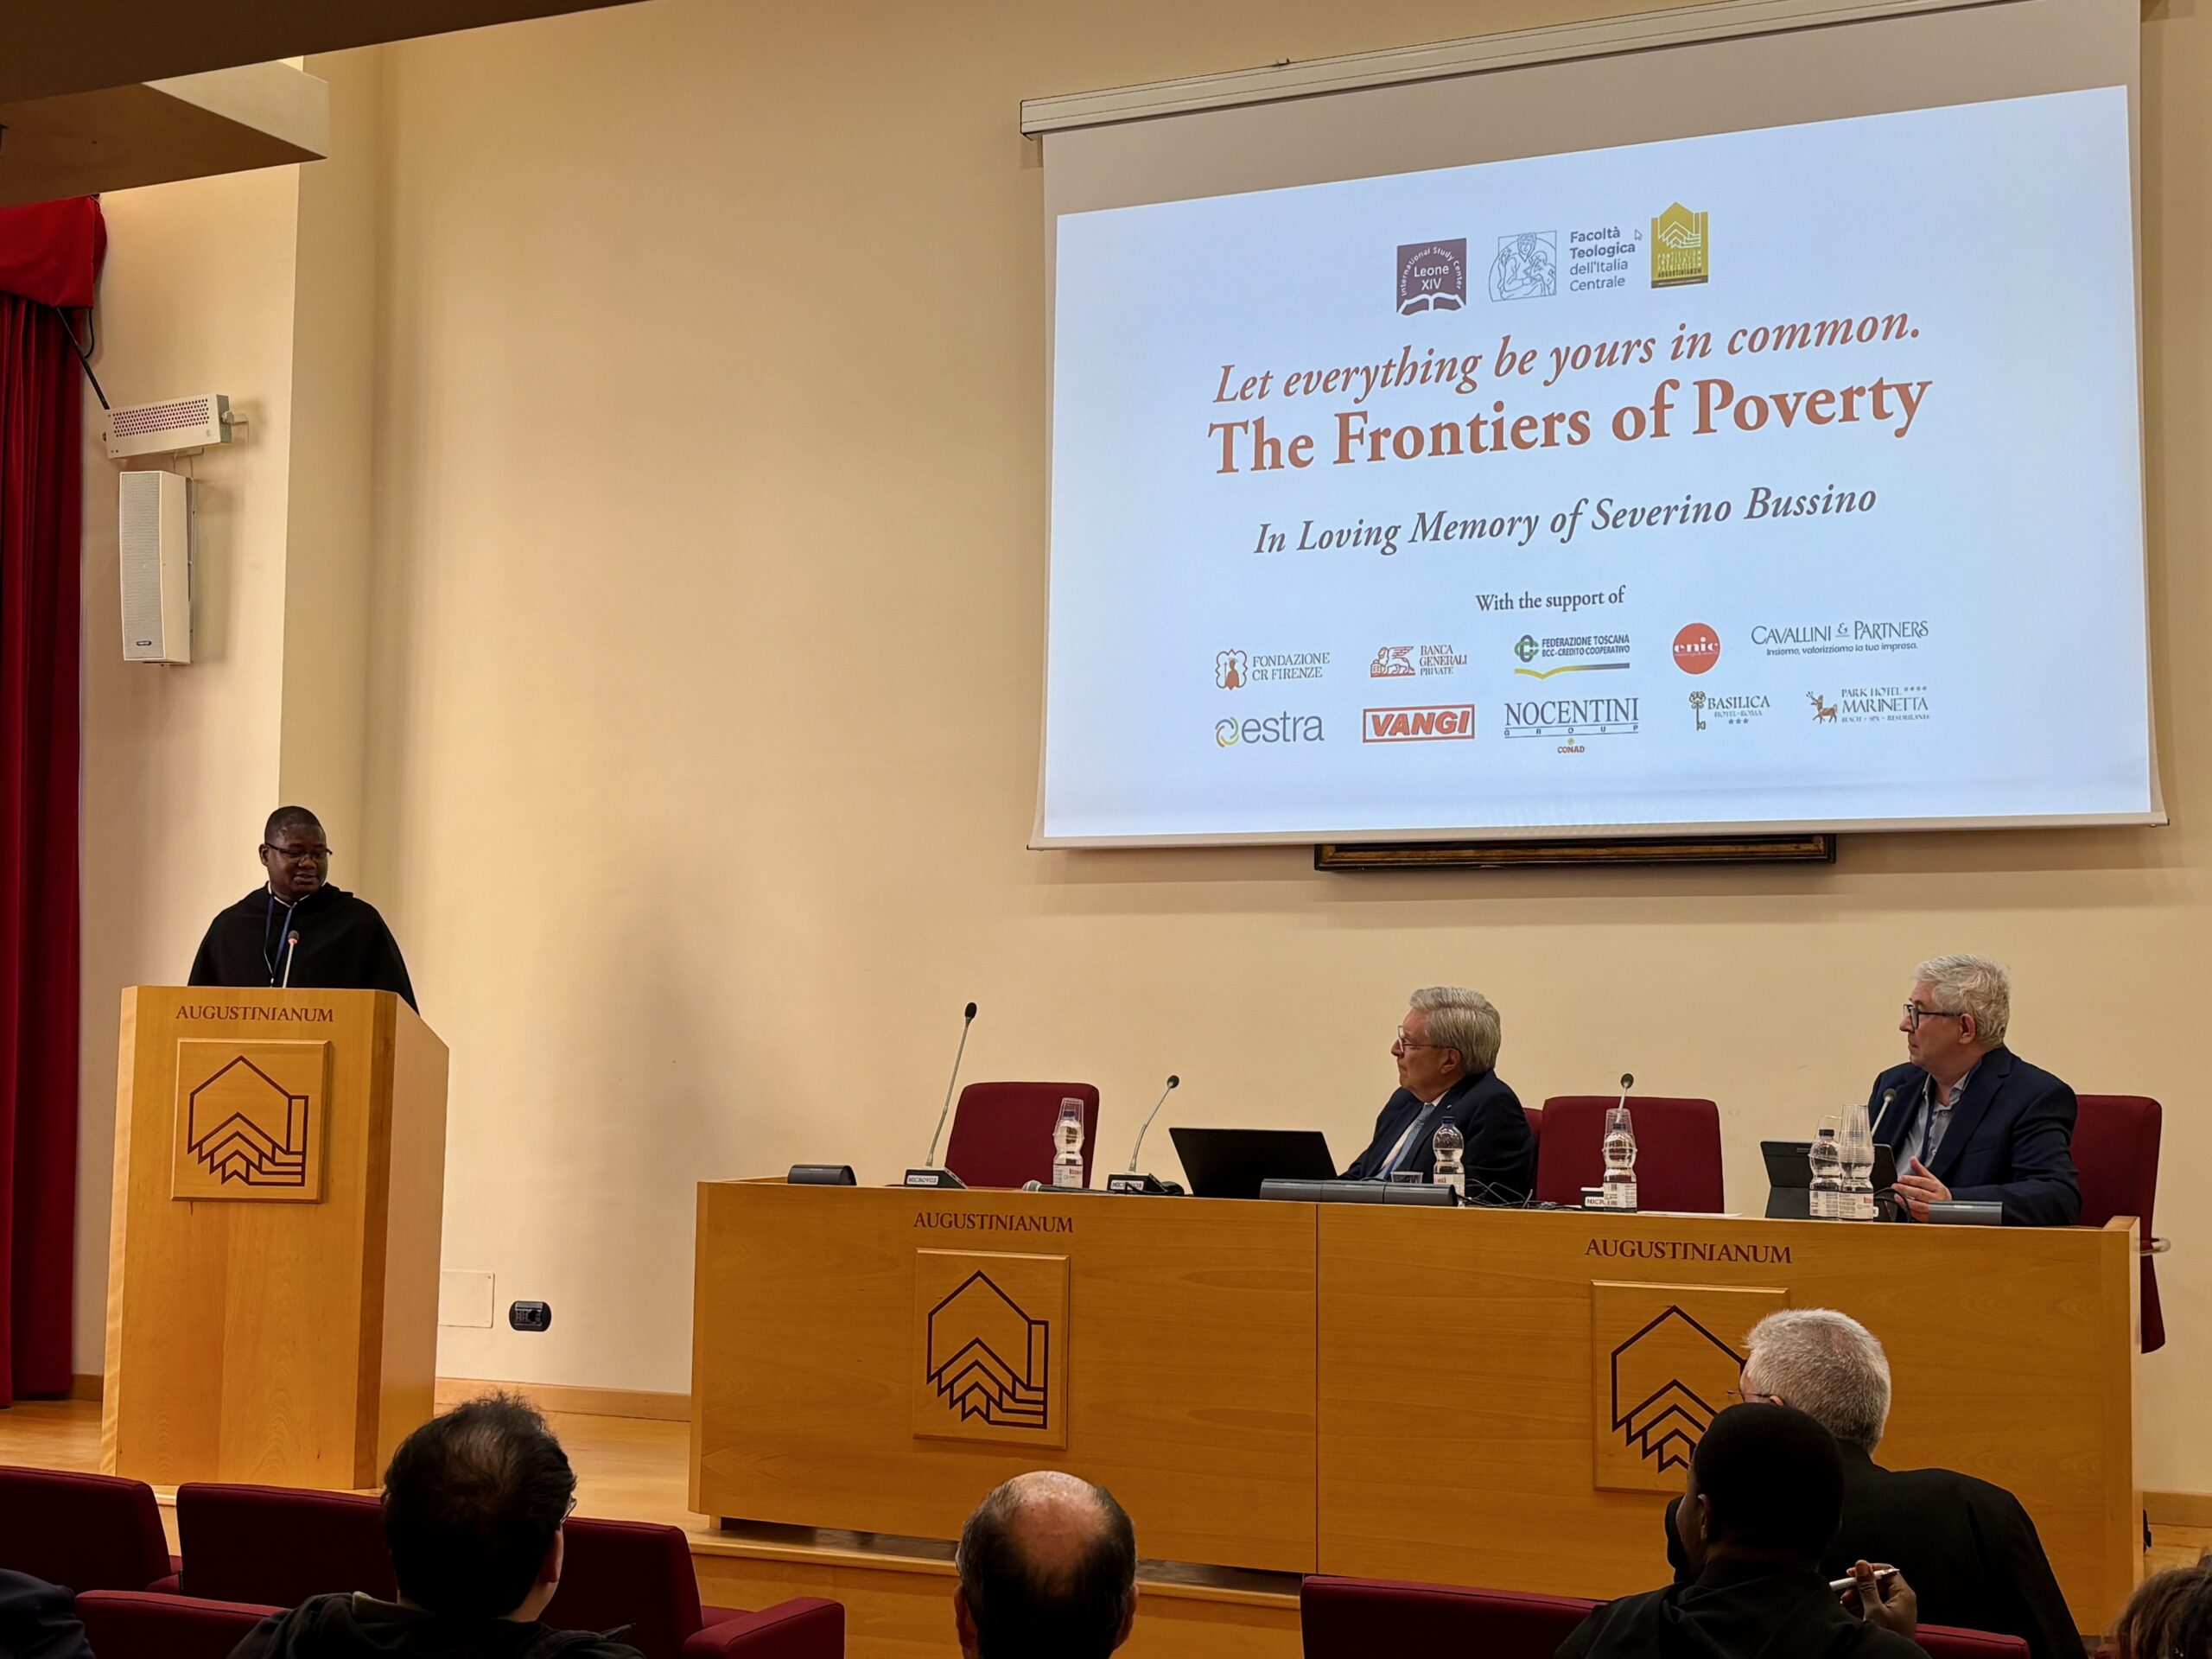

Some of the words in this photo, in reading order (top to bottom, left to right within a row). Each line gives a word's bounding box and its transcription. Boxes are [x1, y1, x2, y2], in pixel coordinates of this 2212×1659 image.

[1570, 226, 1621, 243] Facoltà
[1569, 241, 1636, 259] Teologica
[1414, 265, 1450, 277] Leone
[1433, 246, 1455, 262] Study
[1452, 260, 1463, 289] Center
[1569, 258, 1629, 276] dell'Italia
[1421, 277, 1442, 291] XIV
[1569, 276, 1626, 292] Centrale
[1211, 364, 1274, 404] Let
[1282, 345, 1483, 405] everything
[1493, 334, 1538, 378] be
[1541, 338, 1656, 388] yours
[1669, 321, 1713, 361] in
[1727, 312, 1921, 355] common.
[1207, 415, 1315, 474] The
[1332, 400, 1591, 466] Frontiers
[1611, 378, 1681, 442] of
[1692, 376, 1934, 439] Poverty
[1254, 523, 1286, 555] In
[1296, 516, 1402, 556] Loving
[1408, 510, 1540, 547] Memory
[1549, 497, 1590, 544] of
[1591, 495, 1732, 531] Severino
[1743, 485, 1878, 520] Bussino
[1476, 591, 1514, 612] With
[1518, 591, 1542, 608] the
[1545, 591, 1605, 613] support
[1608, 584, 1626, 604] of
[1837, 622, 1849, 636] &
[1541, 636, 1592, 648] FEDERAZIONE
[1593, 633, 1630, 646] TOSCANA
[1674, 636, 1719, 653] enic
[1865, 643, 1879, 652] tua
[1421, 644, 1454, 657] BANCA
[1585, 645, 1630, 656] COOPERATIVO
[1252, 652, 1331, 668] FONDAZIONE
[1419, 654, 1467, 667] GENERALI
[1252, 669, 1269, 681] CR
[1271, 666, 1324, 680] FIRENZE
[1420, 666, 1454, 677] PRIVATE
[1841, 688, 1868, 698] PARK
[1870, 686, 1902, 697] HOTEL
[1707, 695, 1770, 710] BASILICA
[1841, 696, 1929, 714] MARINETTA
[1504, 697, 1639, 726] NOCENTINI
[1241, 710, 1325, 744] estra
[1370, 710, 1471, 738] VANGI
[1557, 745, 1586, 754] CONAD
[175, 1006, 334, 1023] AUGUSTINIANUM
[913, 1211, 1073, 1234] AUGUSTINIANUM
[1586, 1238, 1792, 1264] AUGUSTINIANUM
